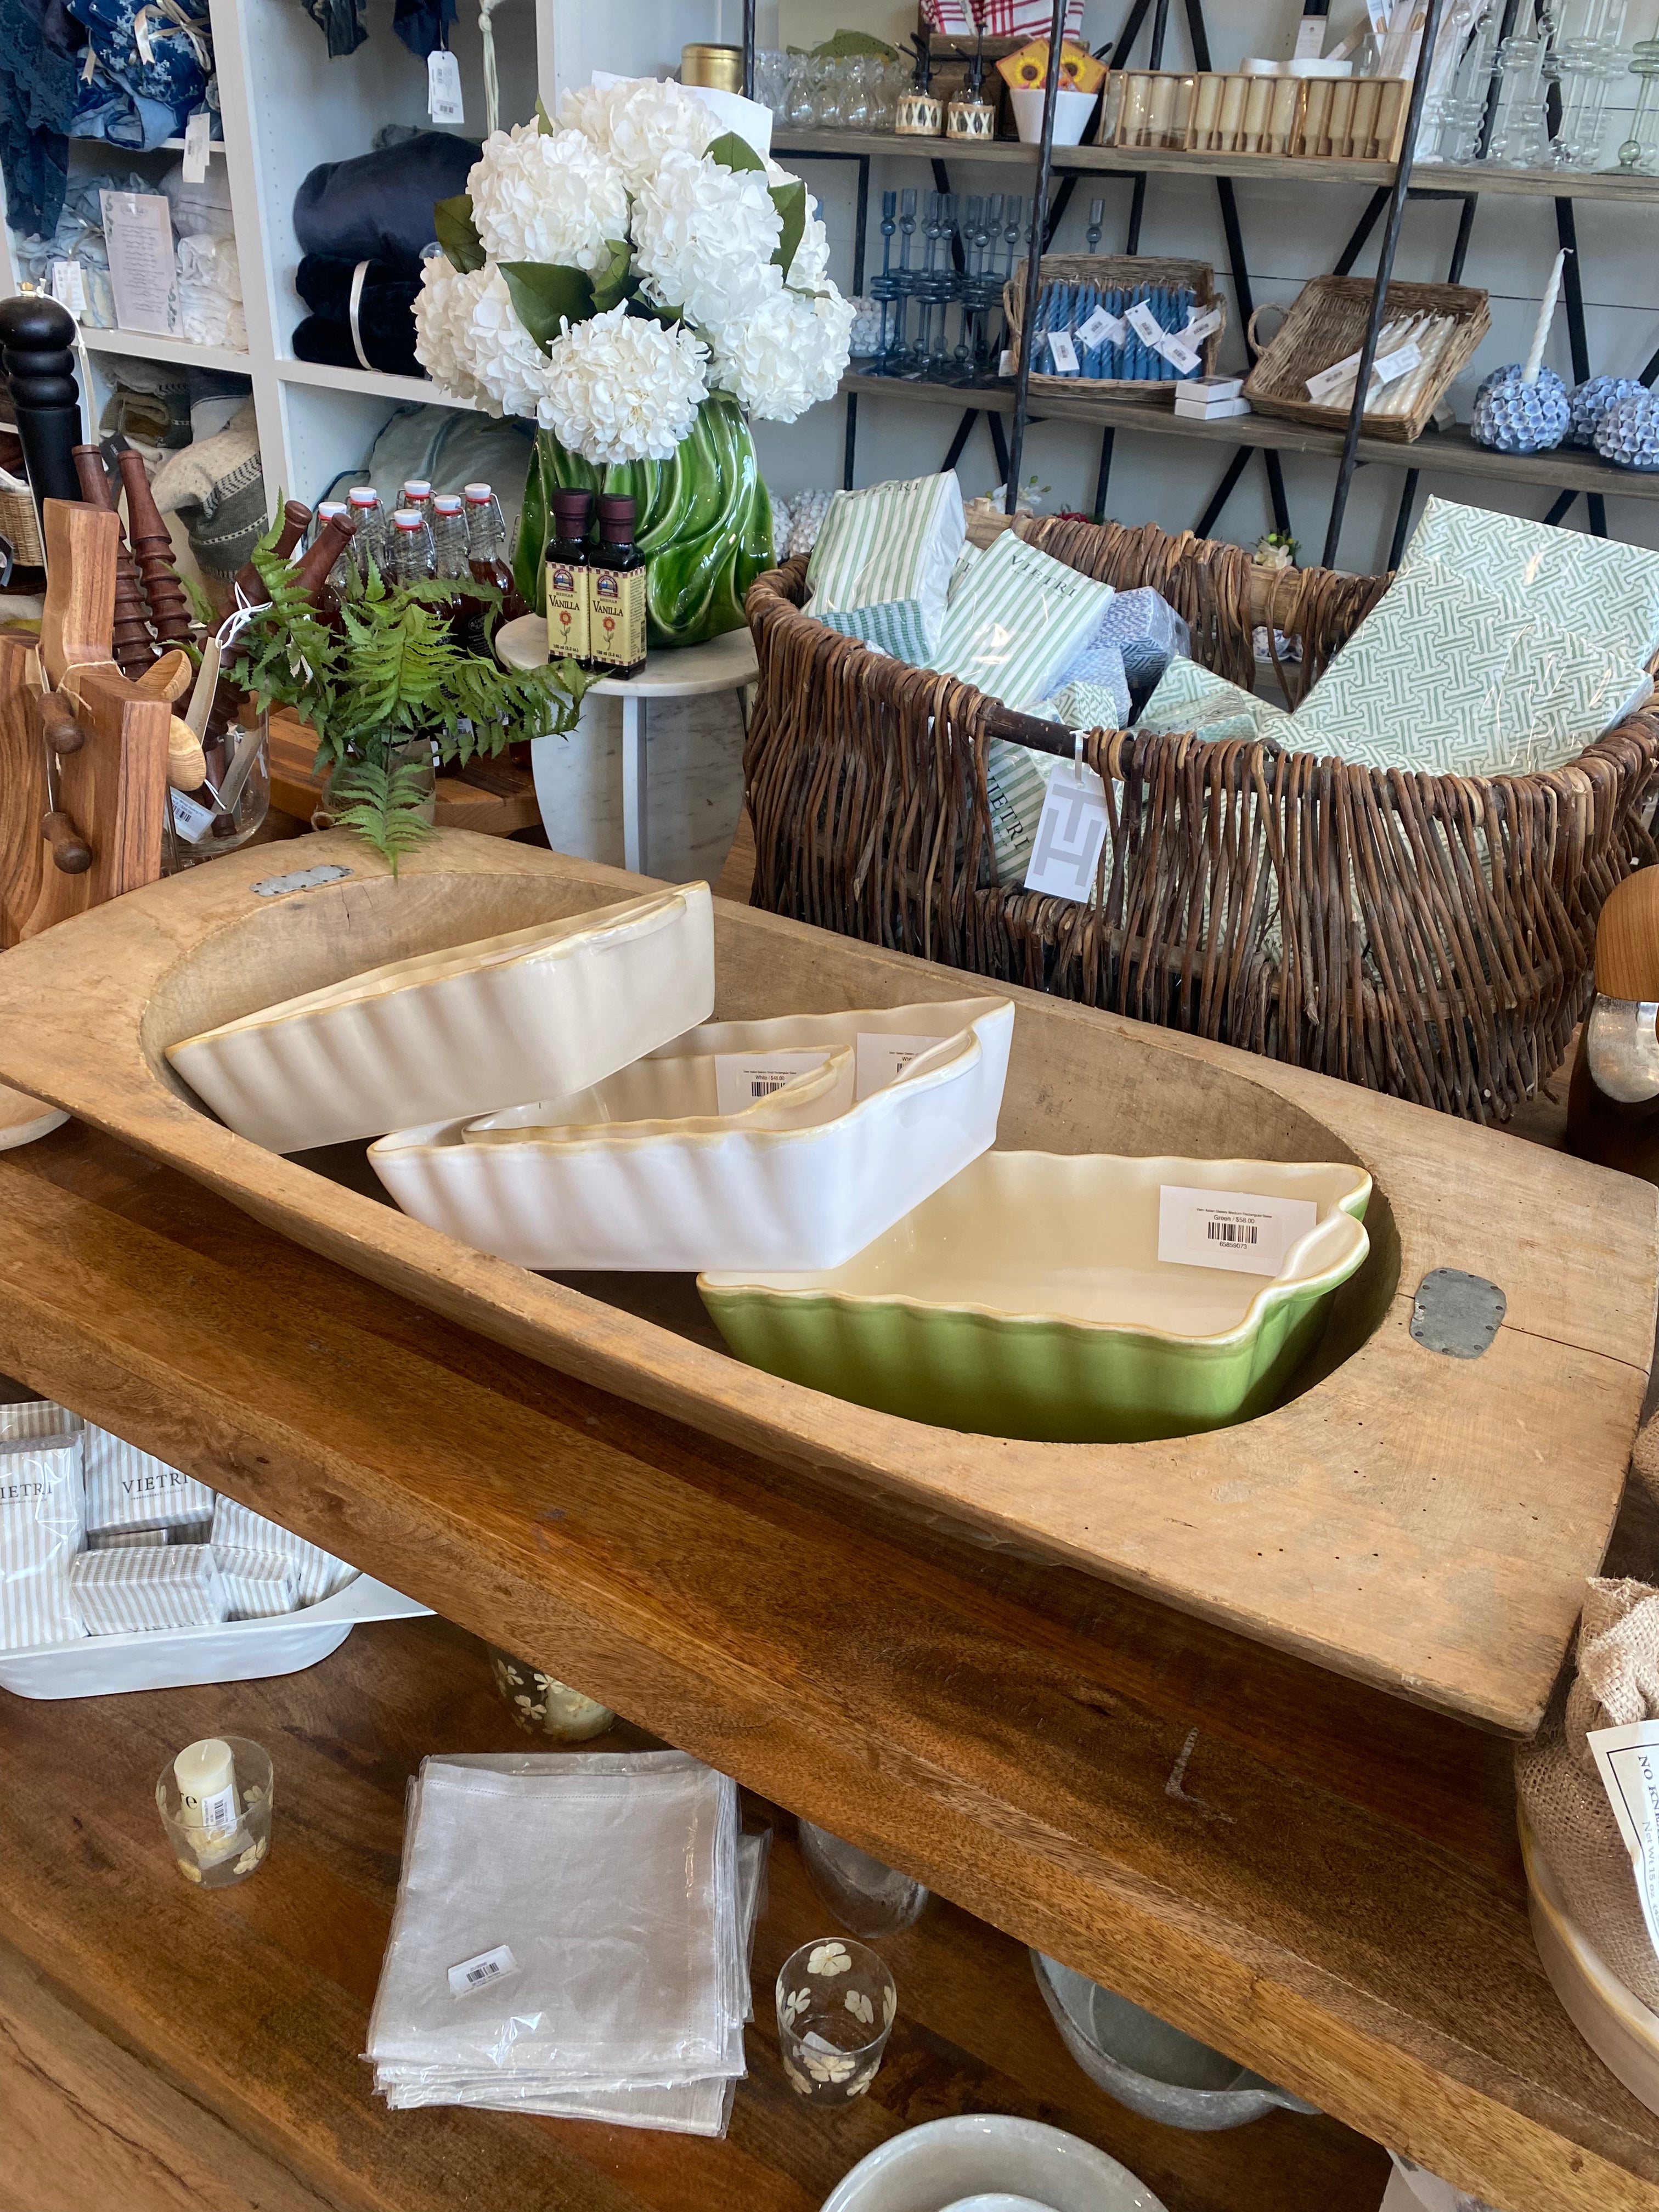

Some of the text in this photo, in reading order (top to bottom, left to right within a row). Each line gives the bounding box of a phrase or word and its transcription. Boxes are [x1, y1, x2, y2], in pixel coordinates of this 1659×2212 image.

[1011, 555, 1077, 598] VIETRI
[548, 594, 580, 611] VANILLA
[592, 600, 624, 617] VANILLA
[1219, 1241, 1248, 1249] 65859073
[0, 1482, 52, 1499] IETRI
[121, 1472, 189, 1493] VIETRI
[1638, 1754, 1653, 1780] NO
[1642, 1821, 1652, 1843] Net
[1648, 1846, 1655, 1865] Wt
[1649, 1867, 1655, 1881] 15
